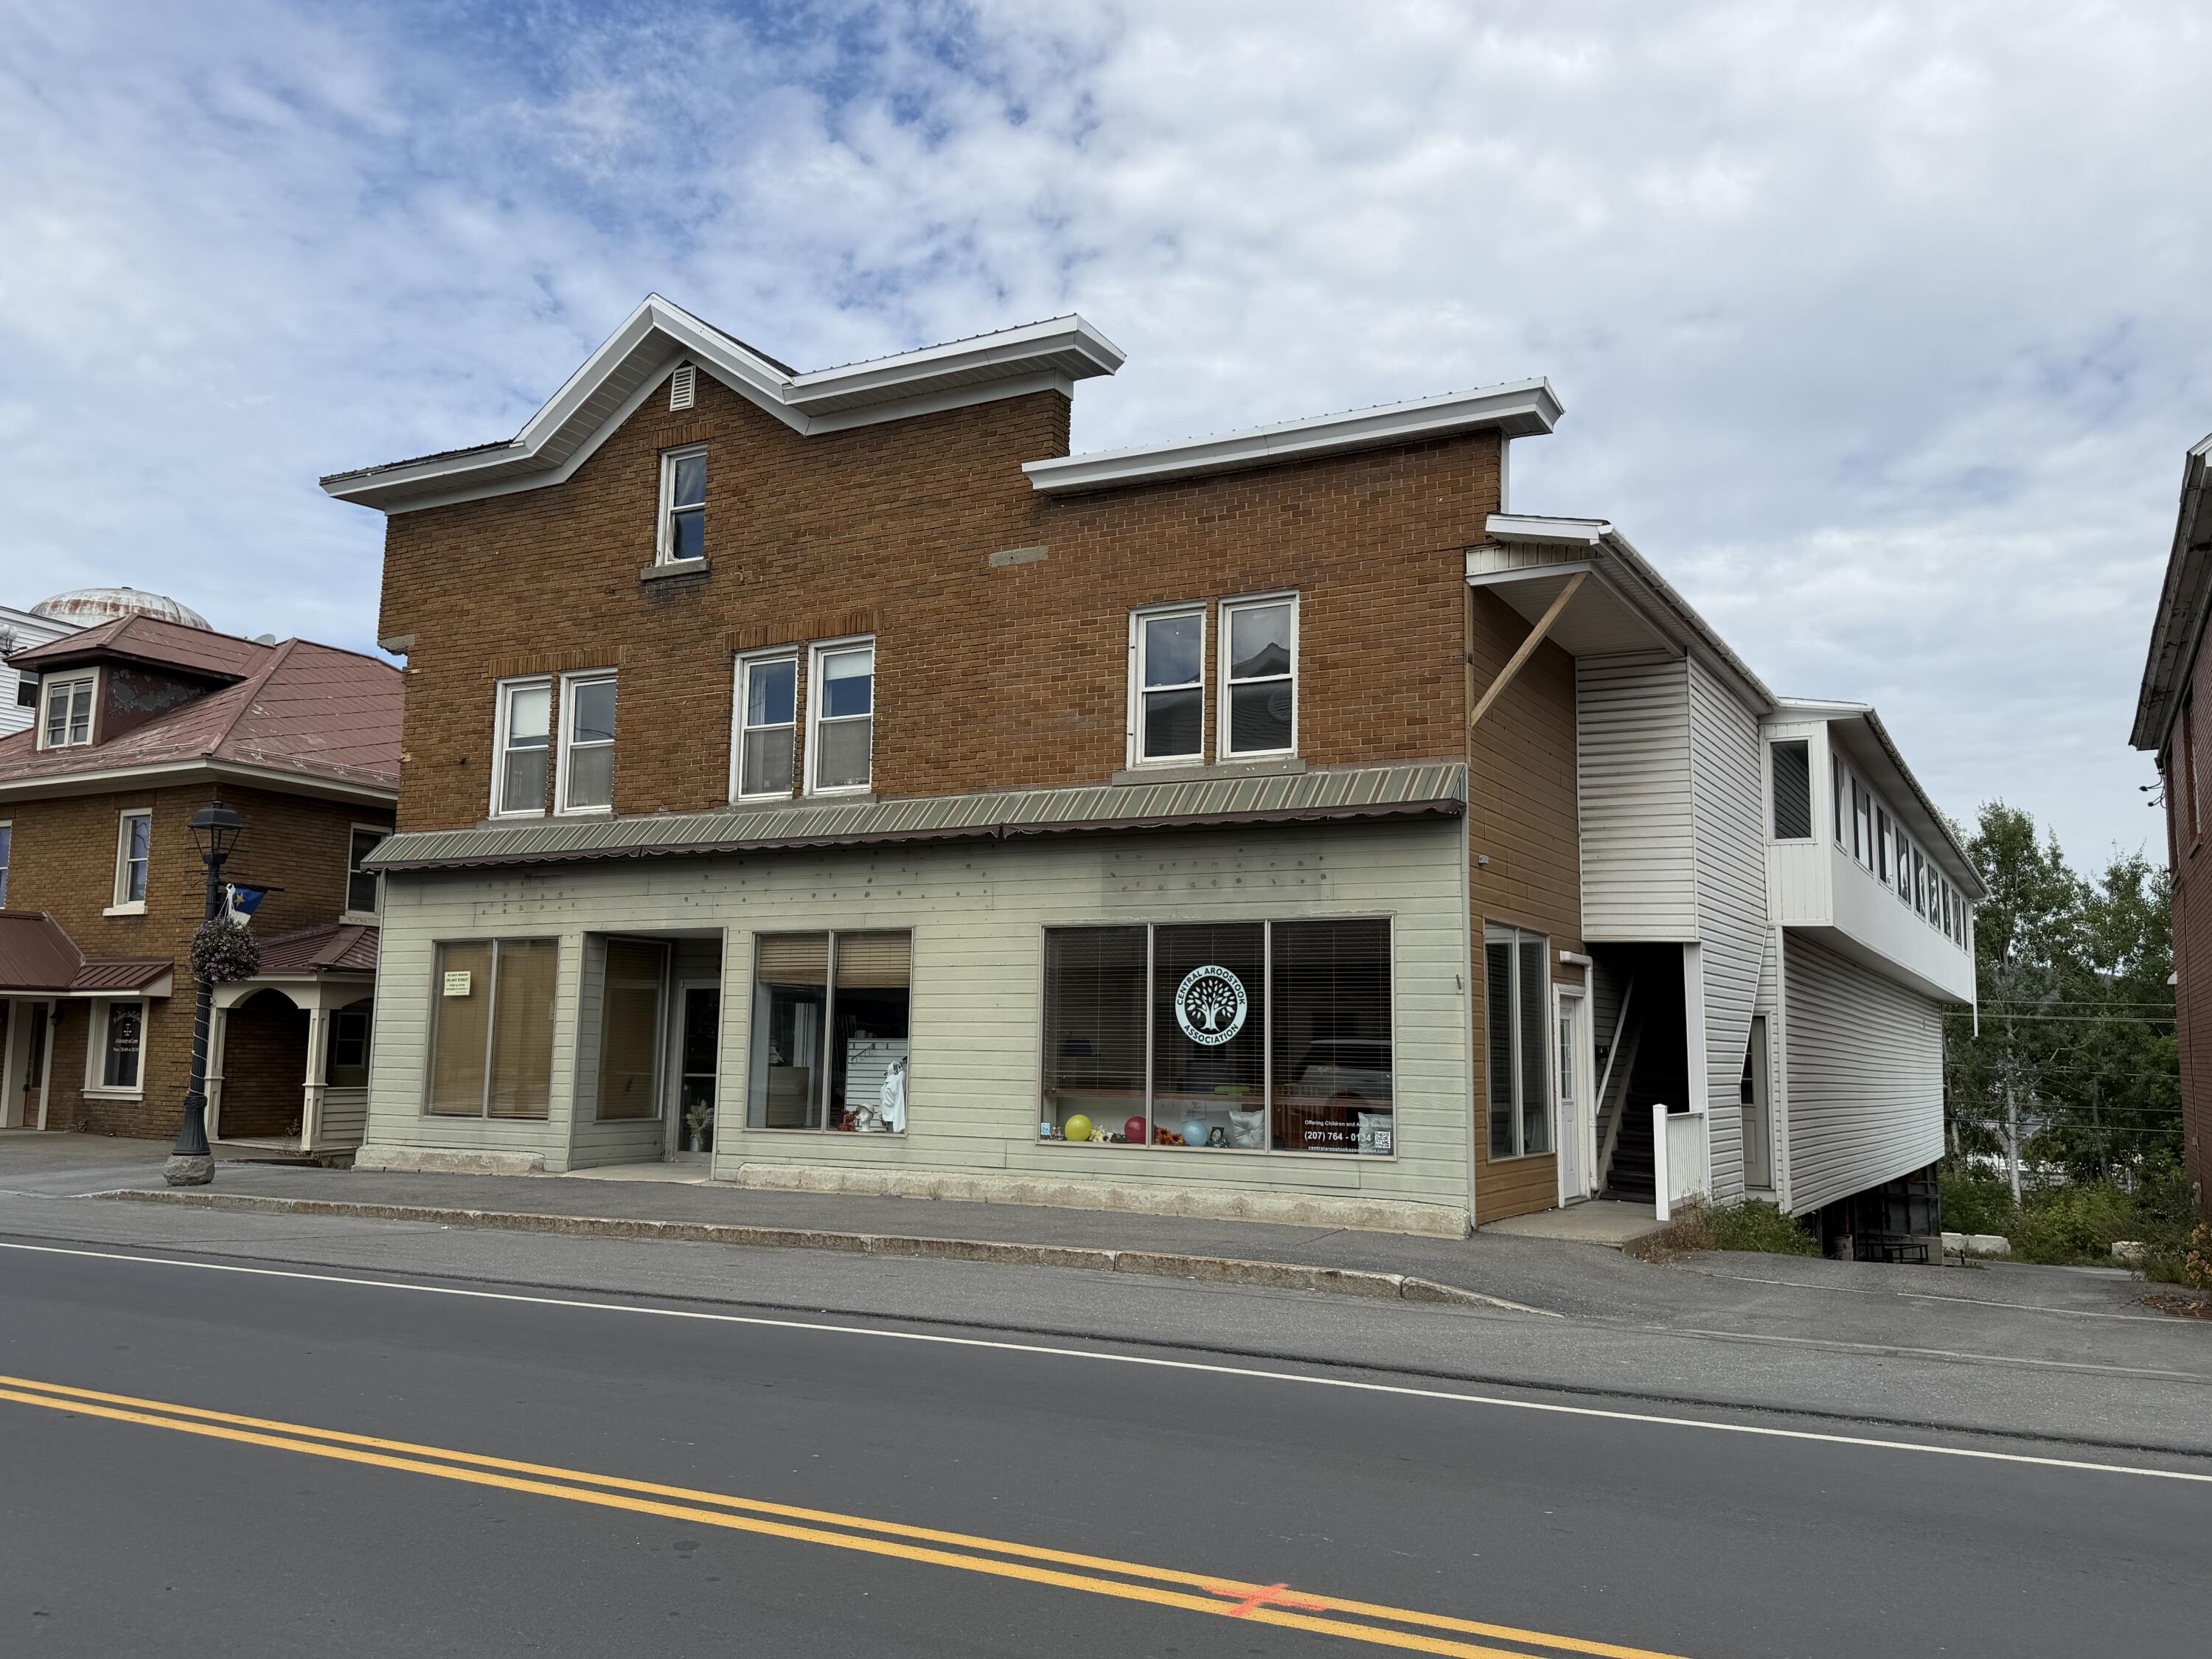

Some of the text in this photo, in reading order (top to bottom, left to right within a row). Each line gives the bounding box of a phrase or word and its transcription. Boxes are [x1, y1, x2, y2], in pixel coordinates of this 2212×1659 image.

[1177, 967, 1245, 1005] CENTRAL AROOSTOOK
[1184, 1024, 1239, 1043] ASSOCIATION
[1304, 1131, 1326, 1142] (207)
[1328, 1132, 1343, 1141] 764
[1351, 1133, 1371, 1142] 0134
